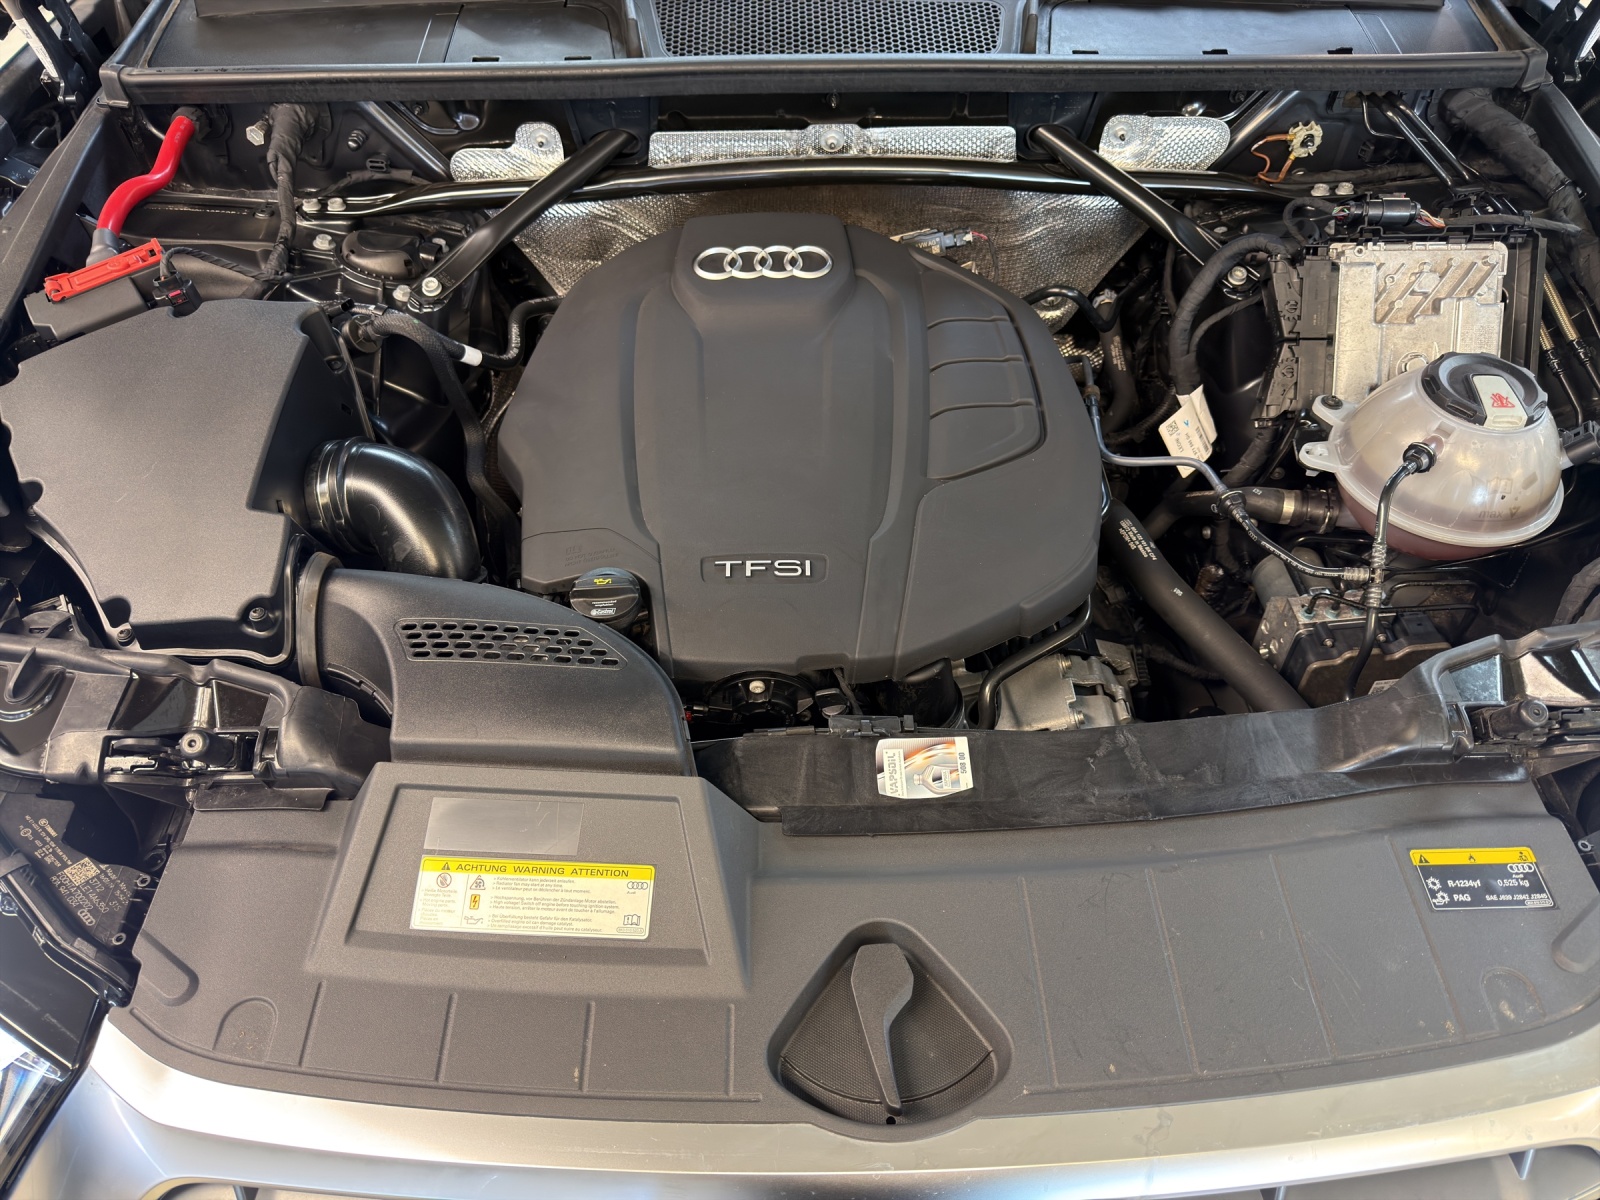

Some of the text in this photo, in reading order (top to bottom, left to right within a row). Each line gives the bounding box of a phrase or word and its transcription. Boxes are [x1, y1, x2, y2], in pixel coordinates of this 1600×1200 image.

[1478, 509, 1503, 518] max
[715, 560, 812, 578] TFSI
[959, 752, 965, 760] 00
[456, 863, 629, 878] ACHTUNG WARNING ATTENTION
[88, 876, 105, 894] 3712
[1447, 879, 1529, 889] R-1234yf 0,525 kg
[1453, 894, 1471, 902] PAG
